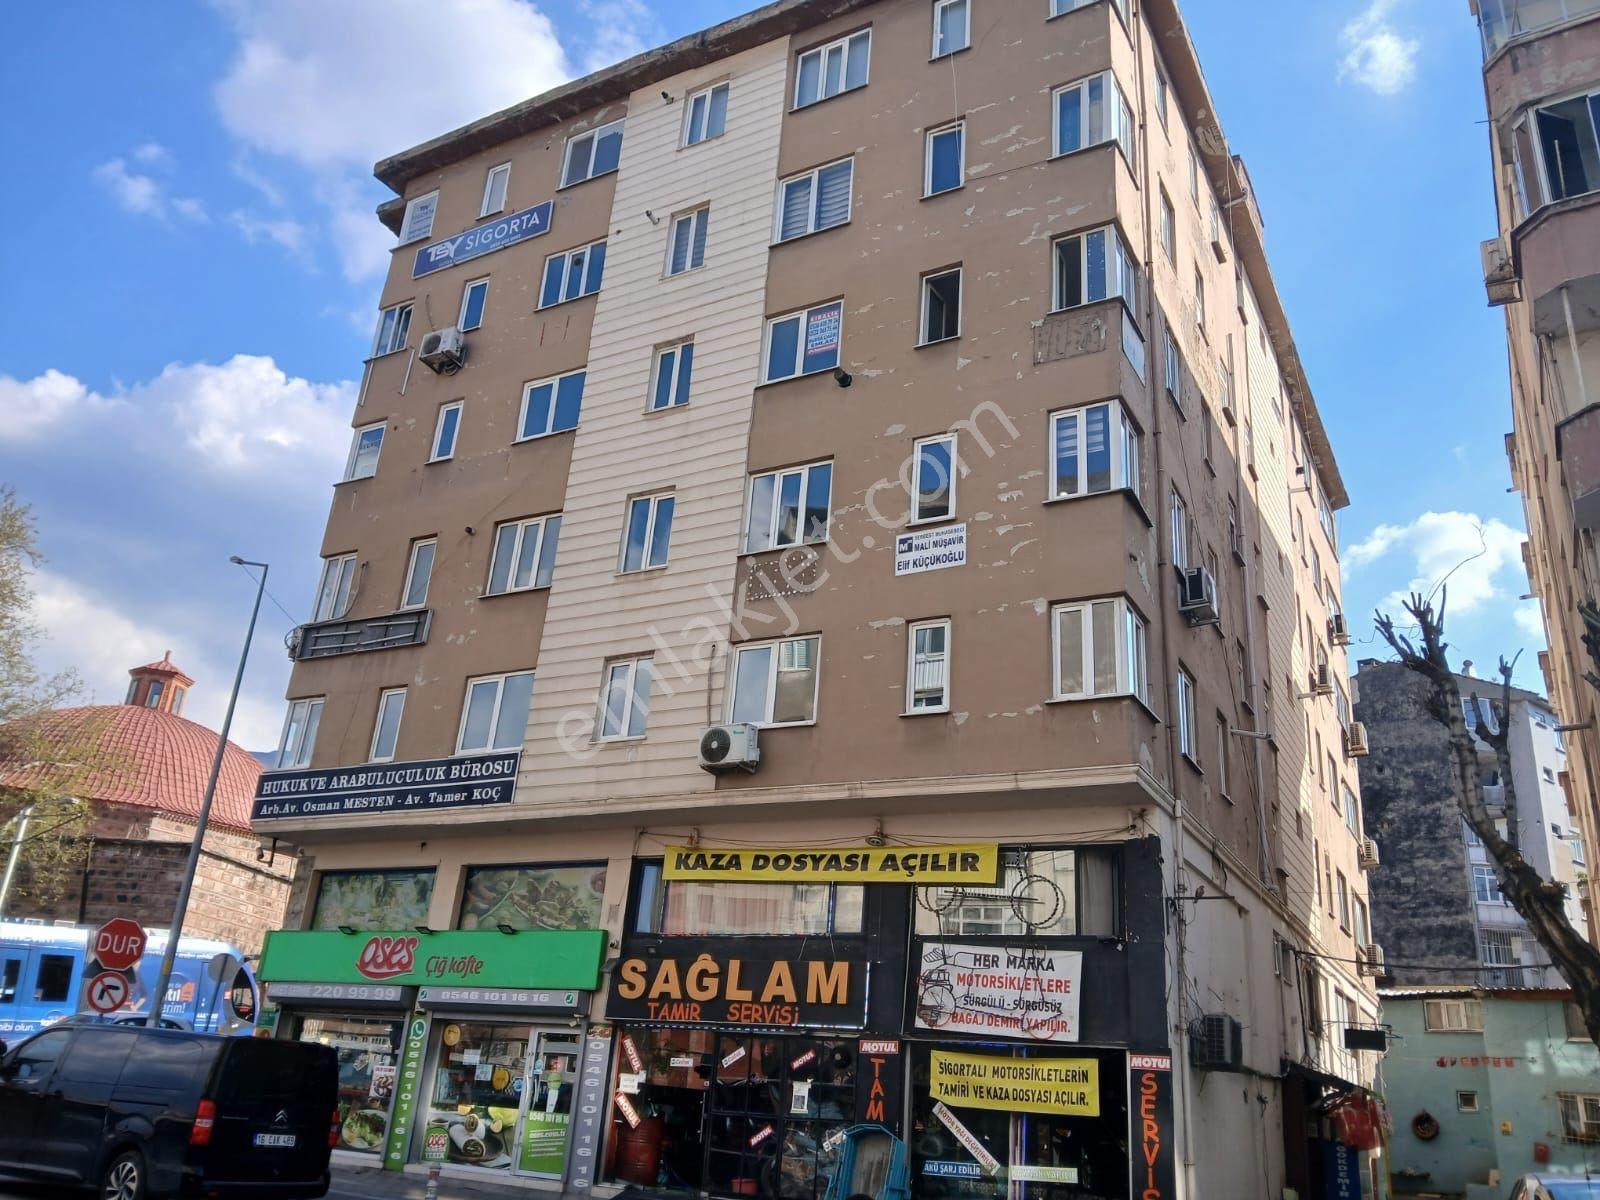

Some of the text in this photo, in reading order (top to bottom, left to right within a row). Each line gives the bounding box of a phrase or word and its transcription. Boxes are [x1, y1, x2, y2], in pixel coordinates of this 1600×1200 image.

[427, 234, 464, 262] TSY
[465, 212, 540, 251] SİGORTA
[914, 535, 964, 551] MALİ MÜŞAVİR
[897, 550, 964, 571] Elif KÜÇÜKOĞLU
[329, 767, 446, 789] ARABULUCULUK
[449, 759, 514, 779] BÜROSU
[302, 800, 340, 812] Osman
[342, 795, 394, 810] MESTEN
[405, 793, 424, 806] Av.
[428, 790, 468, 803] Tamer
[472, 786, 501, 802] KOÇ
[675, 852, 980, 877] KAZA DOSYASI AÇILIR
[100, 933, 141, 956] DUR
[425, 955, 447, 977] Çiğ
[448, 955, 484, 978] köfte
[973, 954, 1055, 972] HER MARKA
[617, 953, 850, 1005] SAĞLAM
[956, 972, 1071, 994] MOTORSİKLETLERE
[312, 985, 343, 998] 220
[349, 987, 369, 999] 99
[374, 988, 395, 1000] 99
[441, 990, 550, 1002] 0546 101 16 16
[963, 994, 1005, 1009] SÜRGÜLÜ
[951, 1013, 984, 1026] BAGAJ
[1026, 1018, 1071, 1034] YAPILIR.
[623, 1038, 641, 1073] MOTUL
[862, 1042, 897, 1052] MOTUL
[792, 1050, 816, 1070] MOTUL
[939, 1059, 1089, 1084] SİGORTALI MOTORSİKLETLERİN
[939, 1081, 1089, 1107] TAMİRİ VE KAZA DOSYASI AÇILIR.
[616, 1096, 640, 1128] MOTUL
[751, 1126, 773, 1146] MOTUL
[924, 1162, 980, 1176] AKÜ ŞARJ EDİLİR
